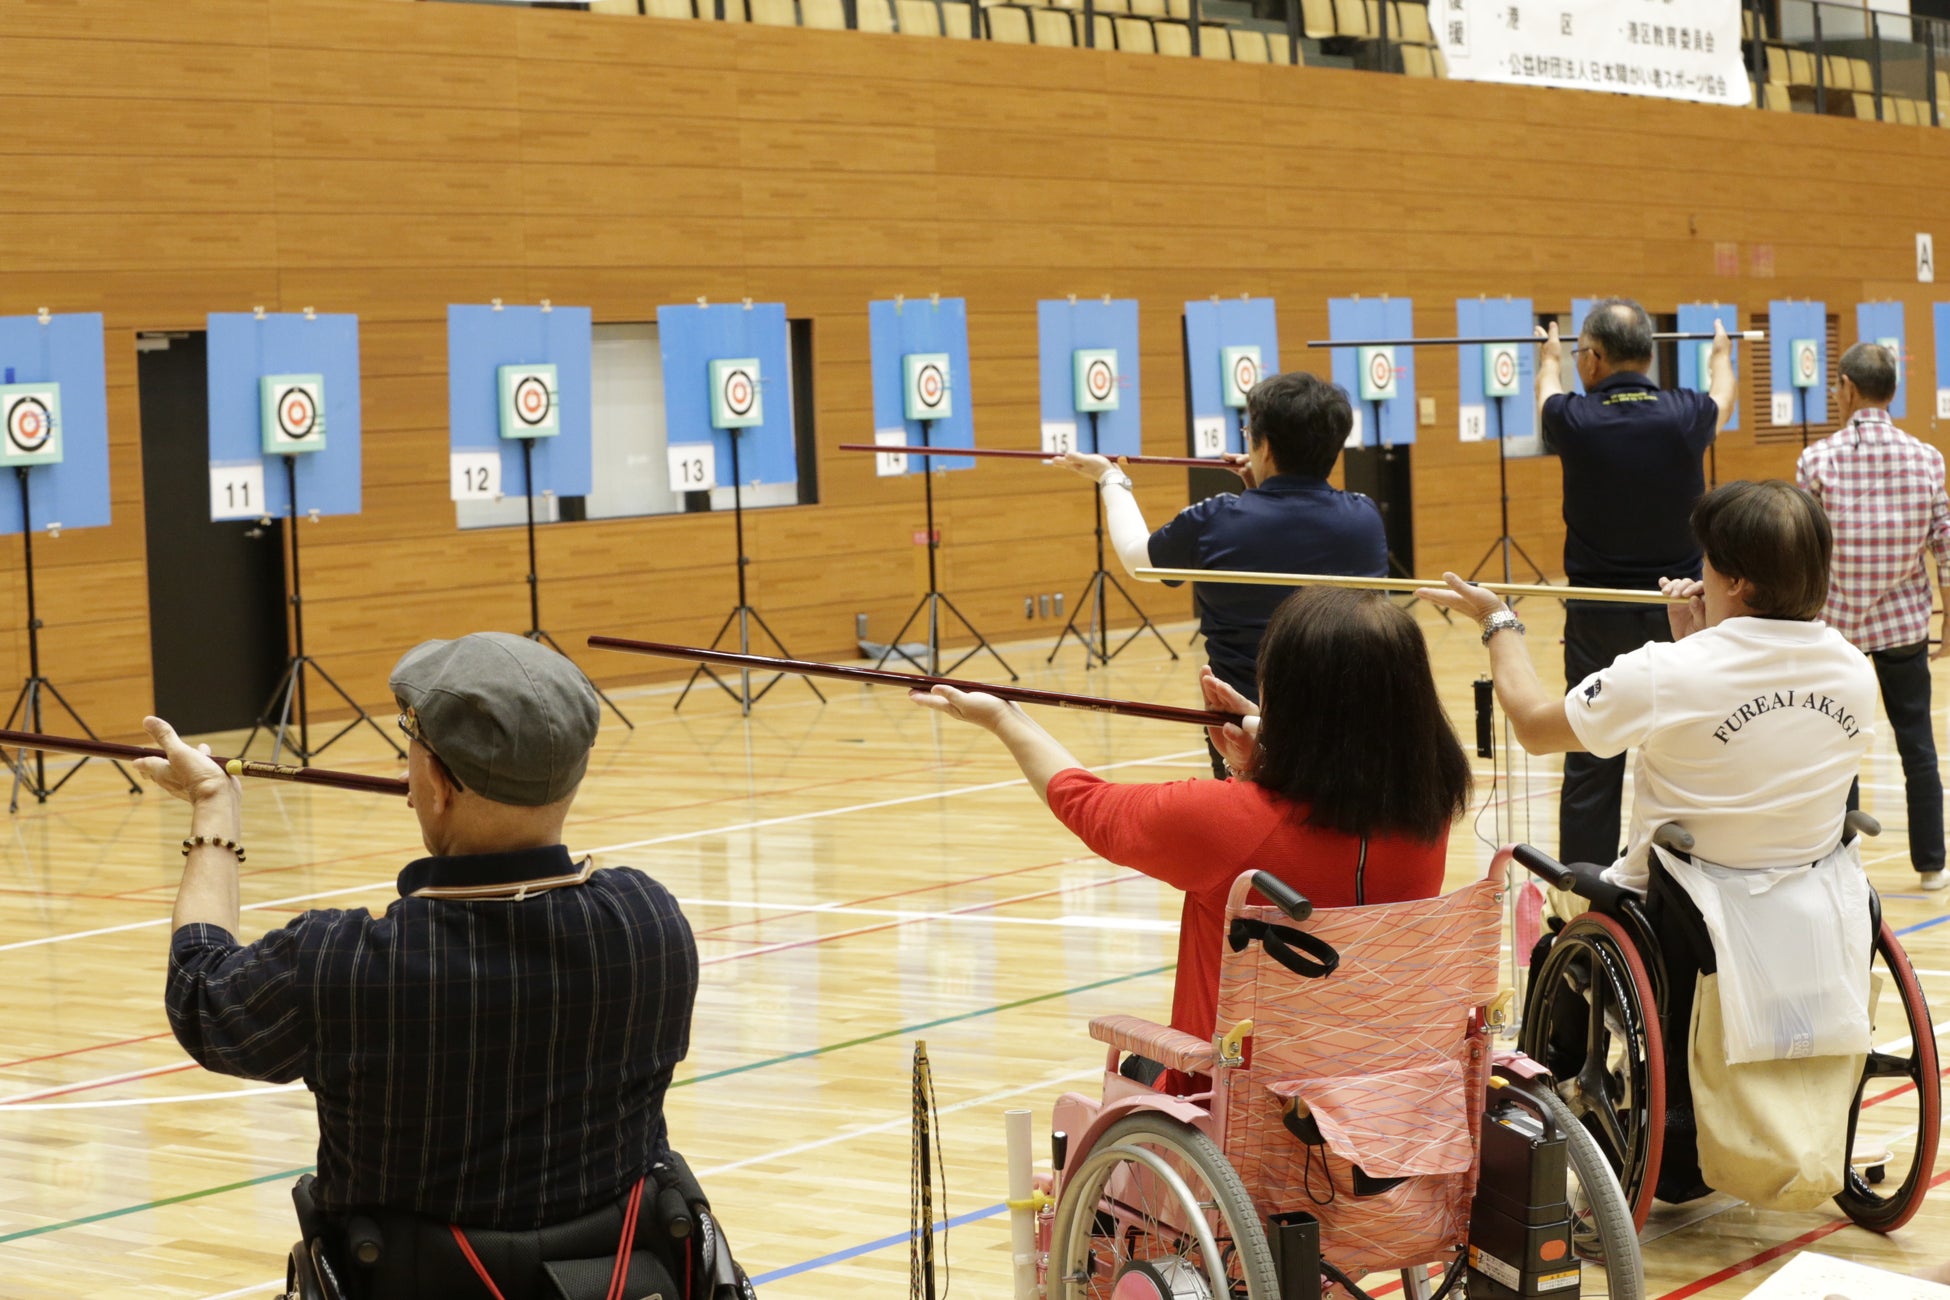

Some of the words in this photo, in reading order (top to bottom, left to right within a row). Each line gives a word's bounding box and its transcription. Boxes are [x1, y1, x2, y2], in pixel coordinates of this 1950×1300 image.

[1627, 21, 1715, 53] 港区教育委員会
[1918, 242, 1932, 273] A
[1051, 433, 1069, 453] 15
[1203, 428, 1220, 449] 16
[464, 467, 489, 491] 12
[681, 459, 704, 482] 13
[226, 482, 250, 508] 11
[1712, 690, 1796, 745] FUREAI
[1802, 692, 1861, 740] AKAGI
